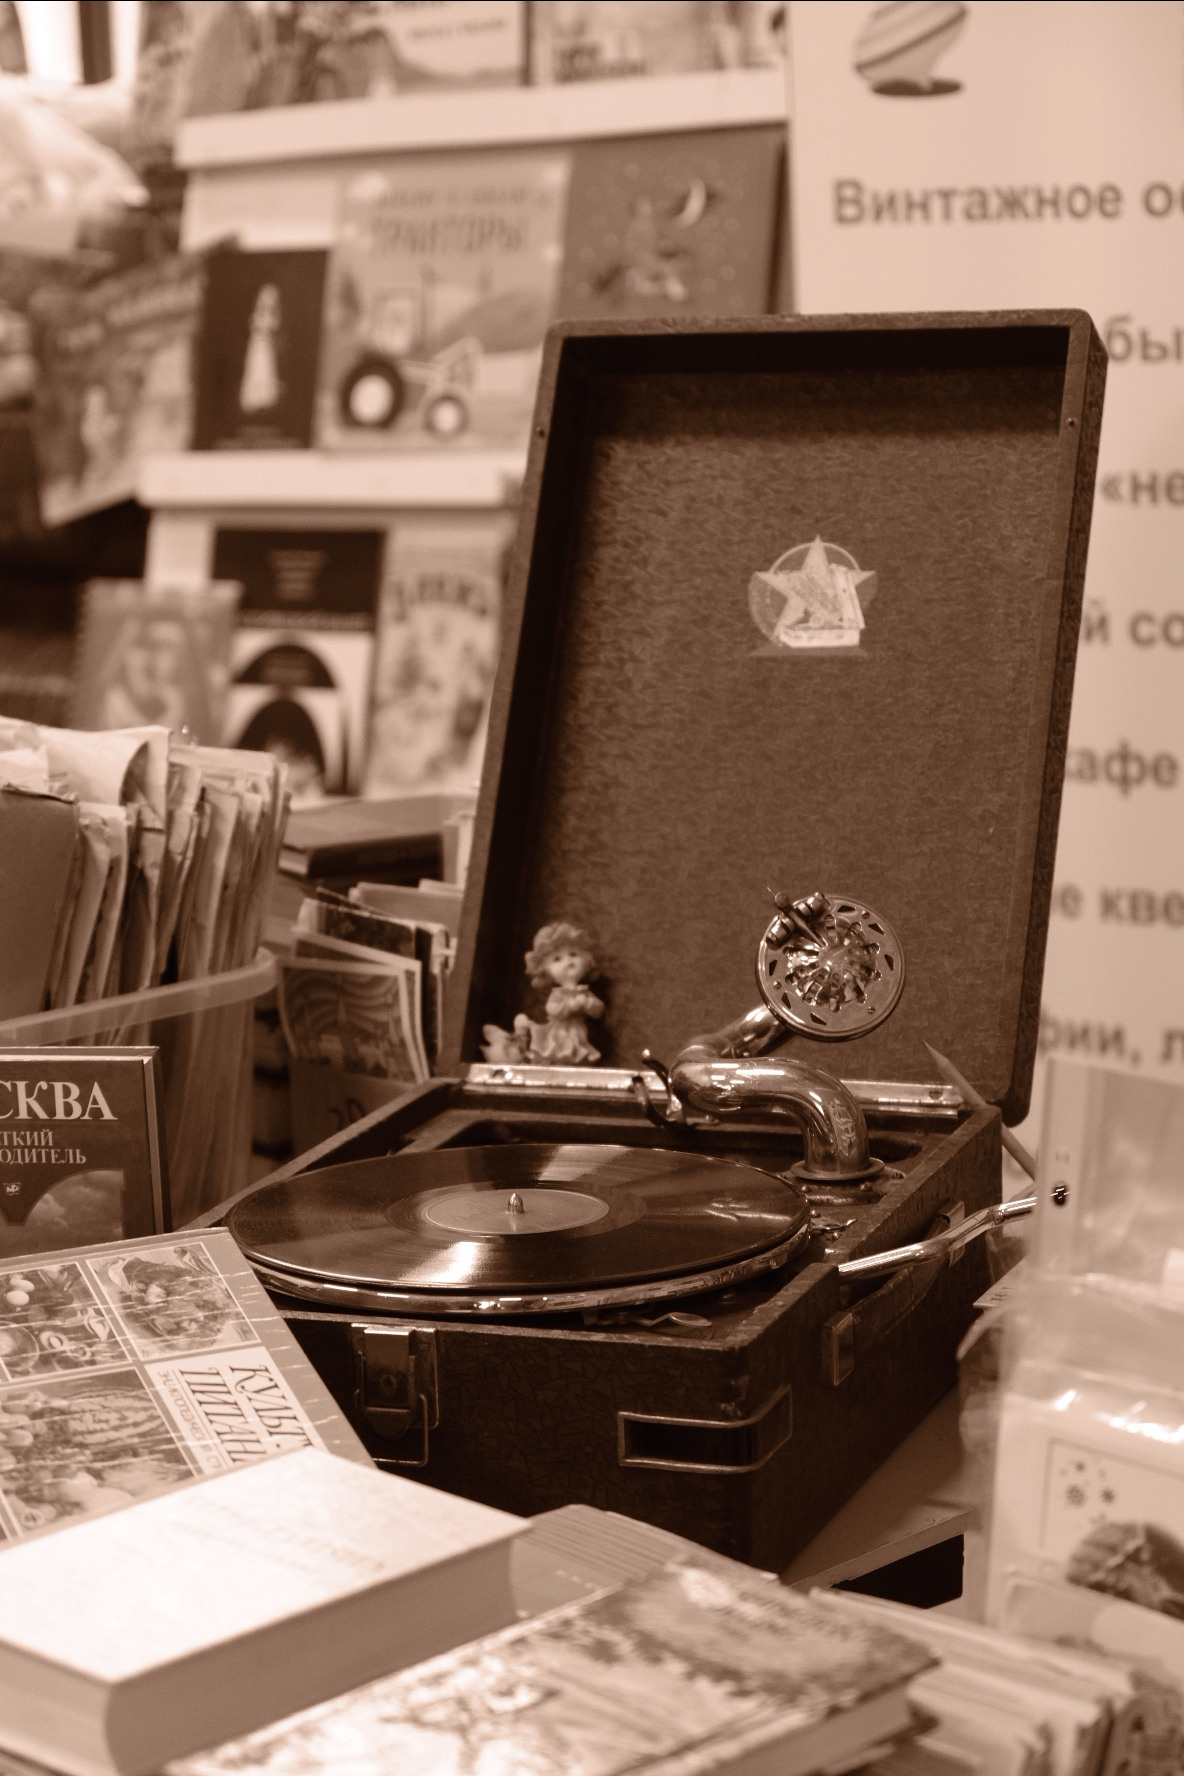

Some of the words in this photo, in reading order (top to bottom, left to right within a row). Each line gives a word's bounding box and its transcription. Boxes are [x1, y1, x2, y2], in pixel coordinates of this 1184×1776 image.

[834, 178, 1122, 224] Винтажное
[1142, 180, 1184, 219] о
[1066, 737, 1179, 798] афе
[0, 1129, 54, 1147] ТКИЙ
[0, 1149, 87, 1165] ОДИТЕЛЬ
[178, 1367, 268, 1463] ПИТАН
